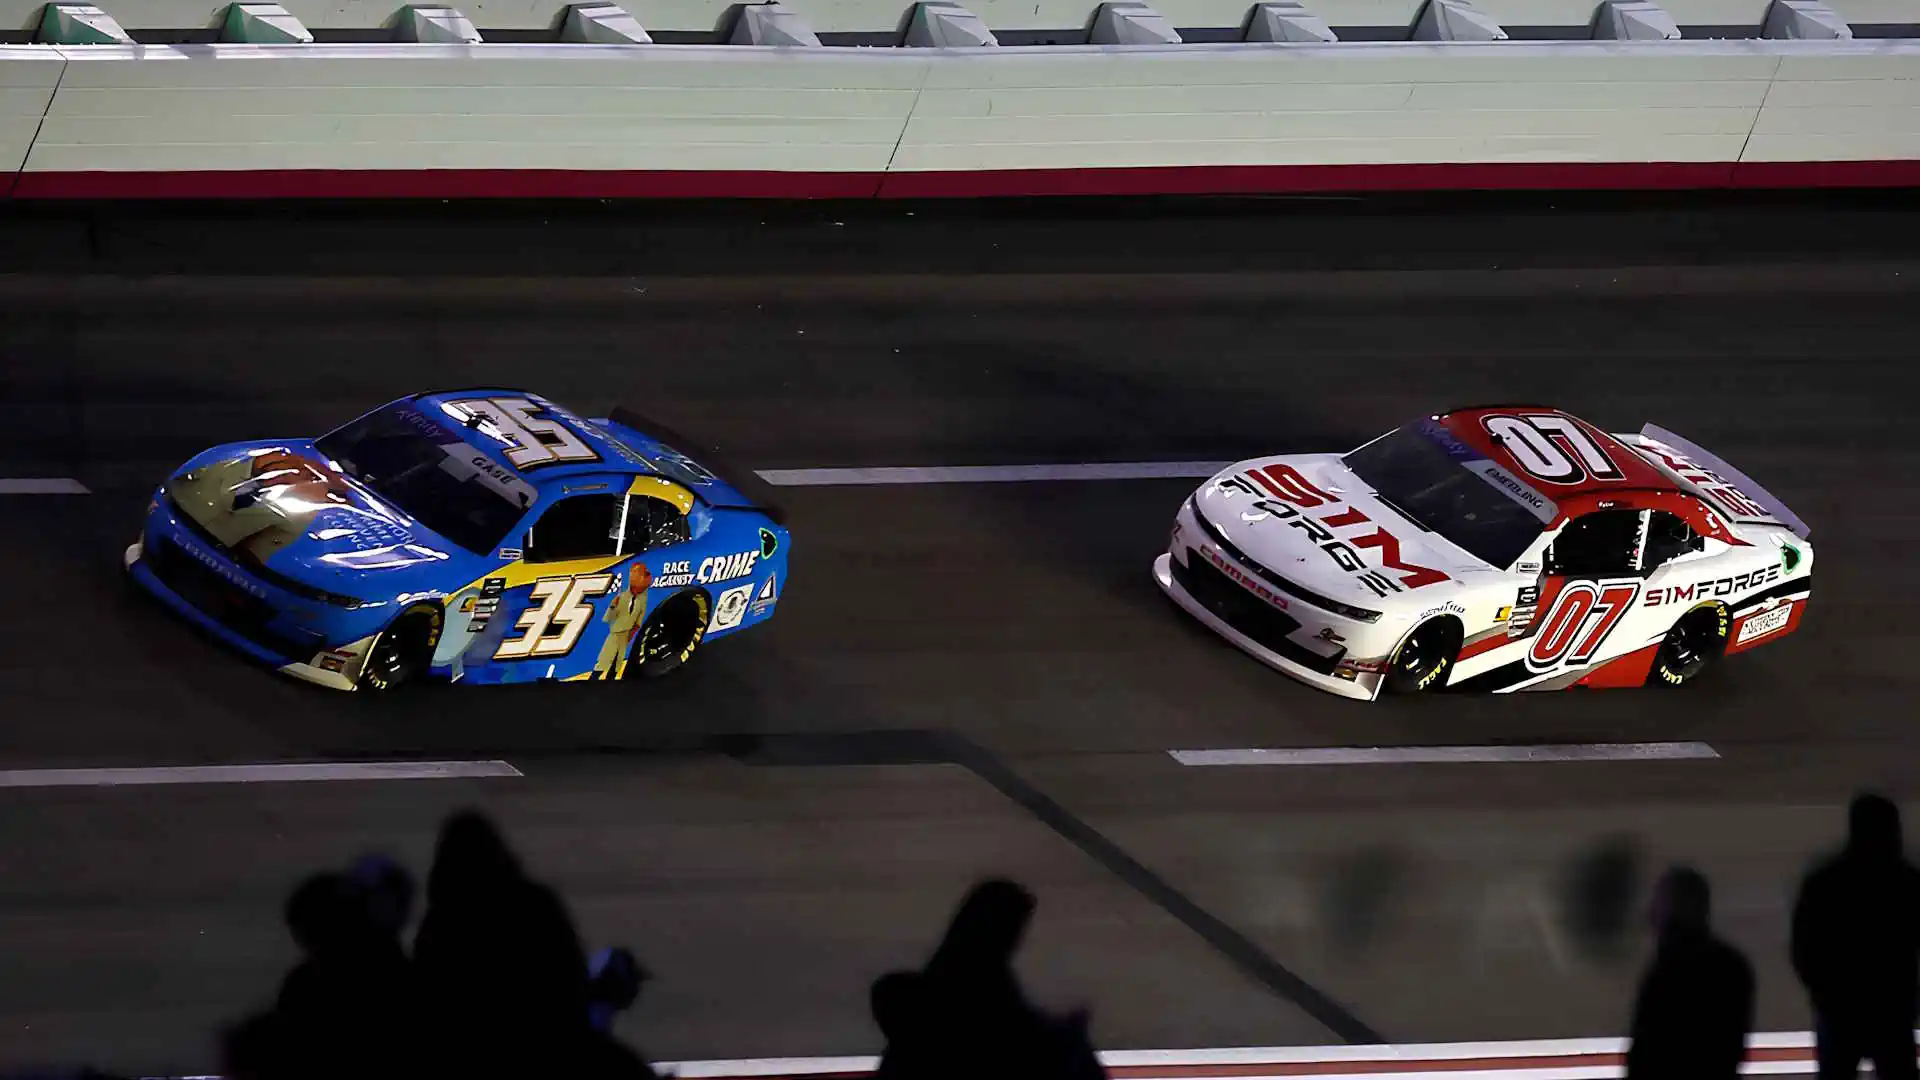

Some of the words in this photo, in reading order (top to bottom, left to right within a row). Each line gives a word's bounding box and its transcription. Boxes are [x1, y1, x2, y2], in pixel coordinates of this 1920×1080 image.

[440, 397, 602, 470] 35
[1479, 413, 1627, 485] 07
[472, 457, 515, 485] GASE
[1484, 468, 1543, 508] EMERLING
[1219, 475, 1403, 598] FORGE
[1245, 464, 1451, 588] SIM
[651, 574, 695, 587] AGAINST
[697, 550, 759, 584] CRIME
[663, 561, 690, 574] RACE
[1643, 564, 1781, 606] SIMFORGE
[493, 574, 614, 661] 35
[1527, 580, 1641, 670] 07
